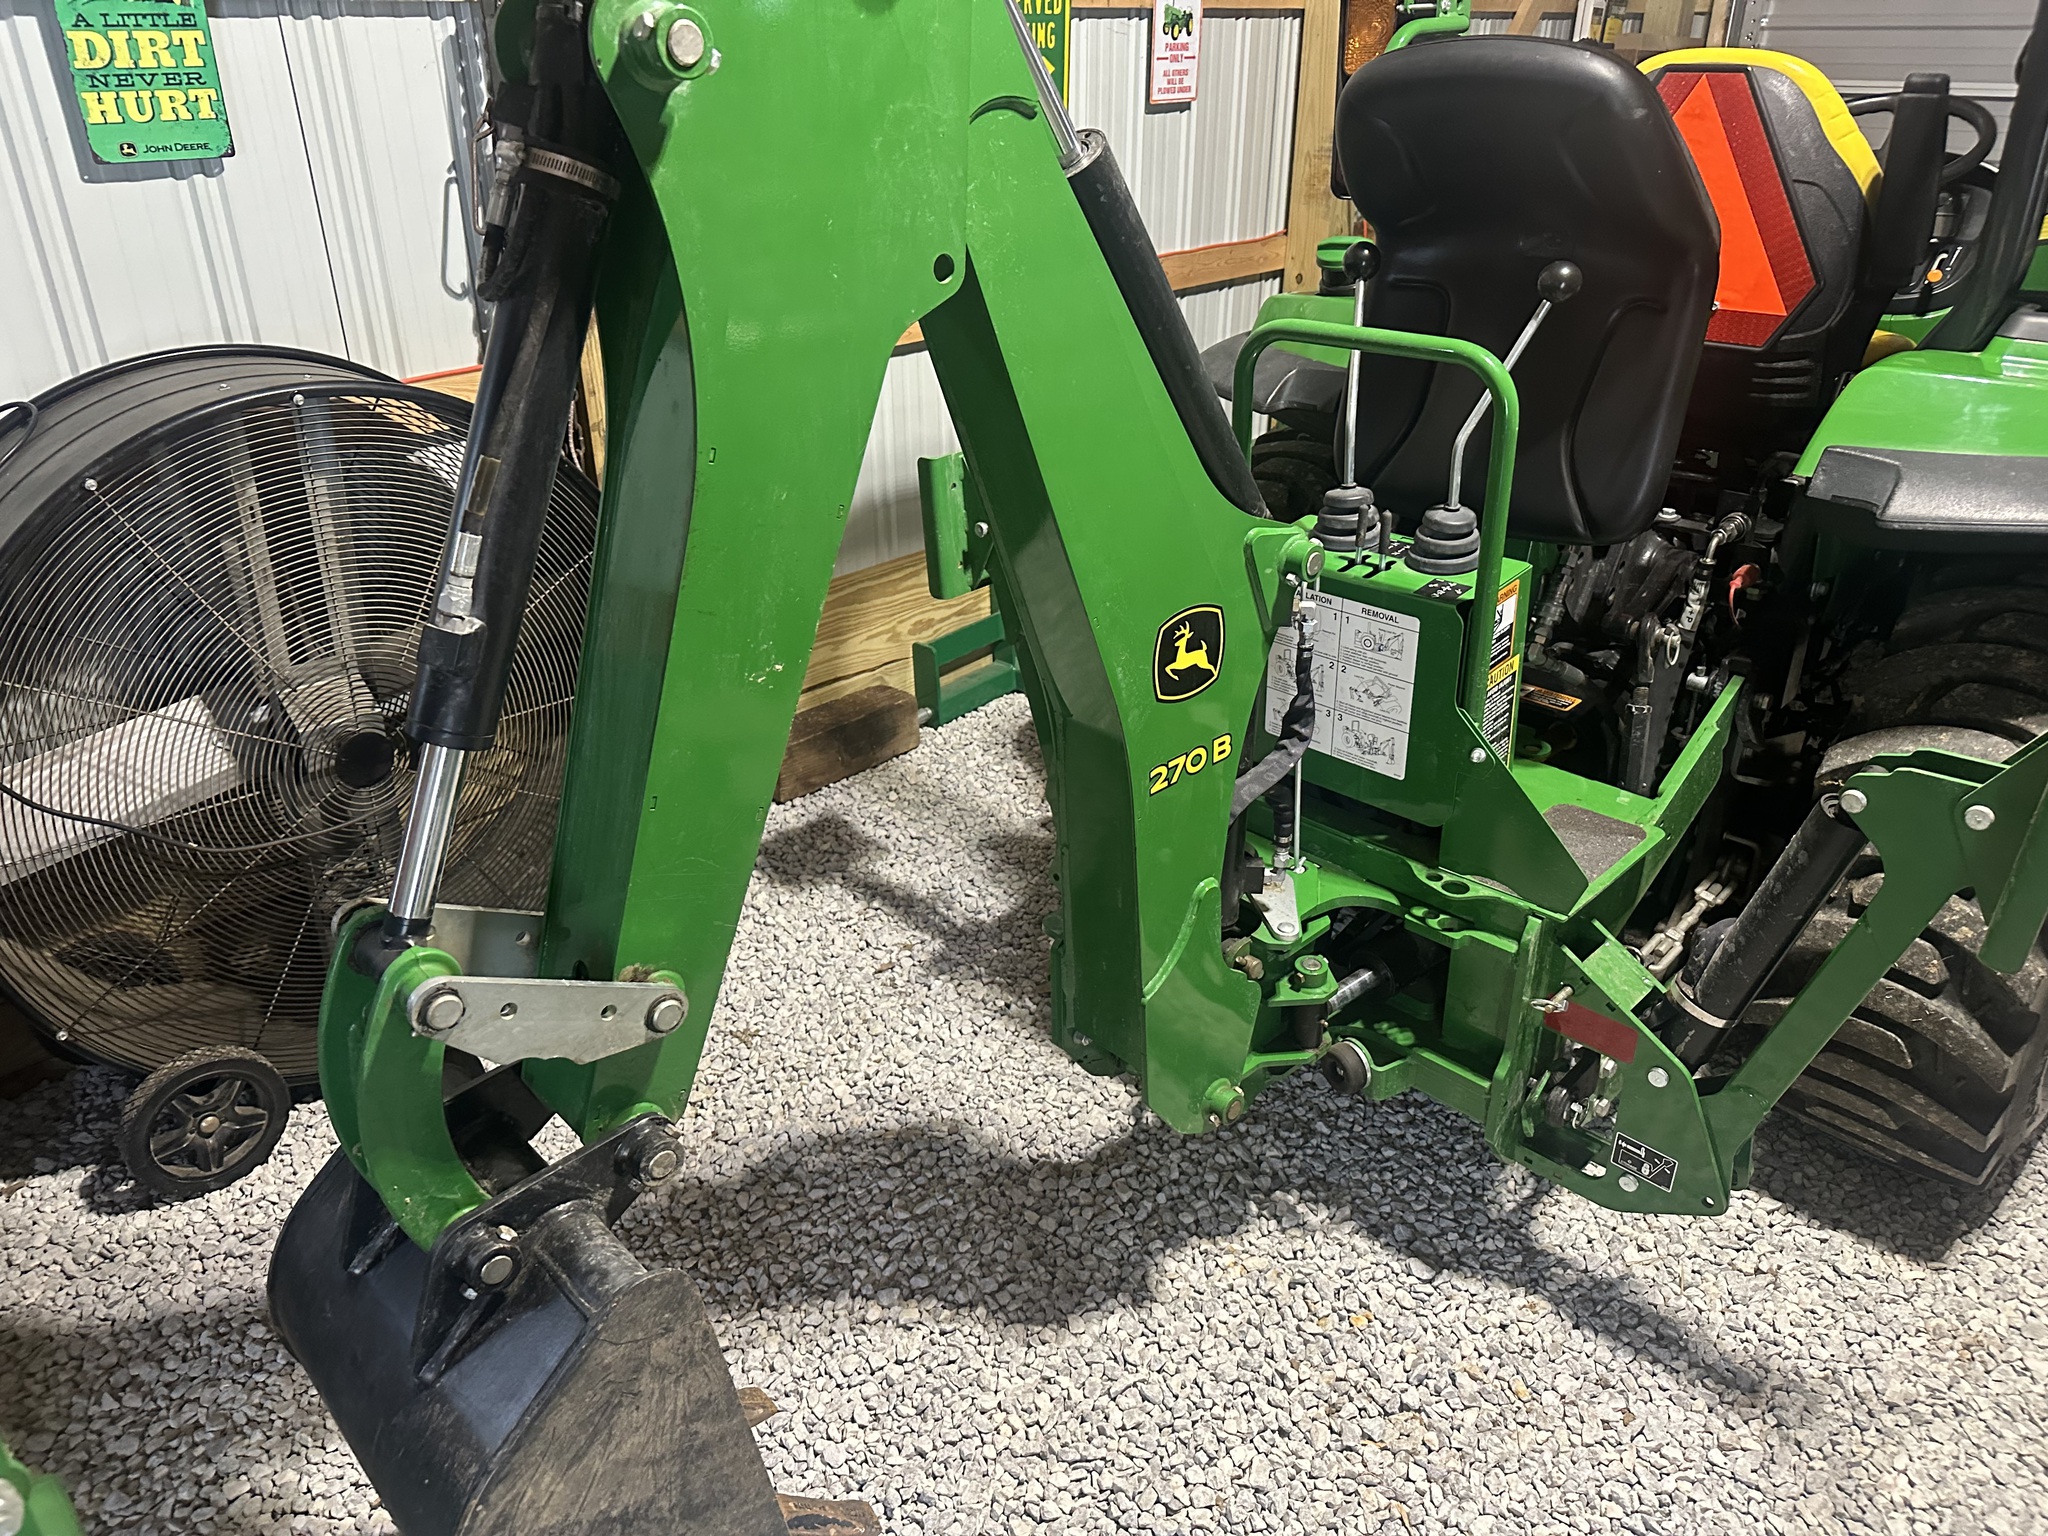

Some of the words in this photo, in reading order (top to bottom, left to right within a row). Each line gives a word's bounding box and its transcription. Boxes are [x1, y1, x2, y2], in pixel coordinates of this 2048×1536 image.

[71, 13, 94, 28] A
[99, 12, 198, 28] LITTLE
[65, 29, 207, 70] DIRT
[1164, 42, 1190, 52] PARKING
[1169, 53, 1184, 63] ONLY
[1162, 69, 1171, 77] ALL
[1171, 68, 1189, 77] OTHERS
[86, 72, 208, 88] NEVER
[1178, 77, 1185, 85] BE
[1157, 86, 1176, 95] PLOWED
[1176, 85, 1192, 94] UNDER
[80, 88, 219, 125] HURT
[142, 143, 173, 154] JOHN
[176, 142, 211, 152] DEERE
[1498, 584, 1518, 601] RNING
[1333, 613, 1338, 621] 1
[1345, 616, 1350, 624] 1
[1360, 607, 1400, 624] REMOVAL
[1328, 661, 1335, 670] 2
[1340, 665, 1347, 674] 2
[1488, 660, 1515, 686] AUTION
[1325, 709, 1331, 718] 3
[1337, 713, 1343, 722] 3
[1149, 744, 1208, 796] 270
[1212, 732, 1232, 765] B
